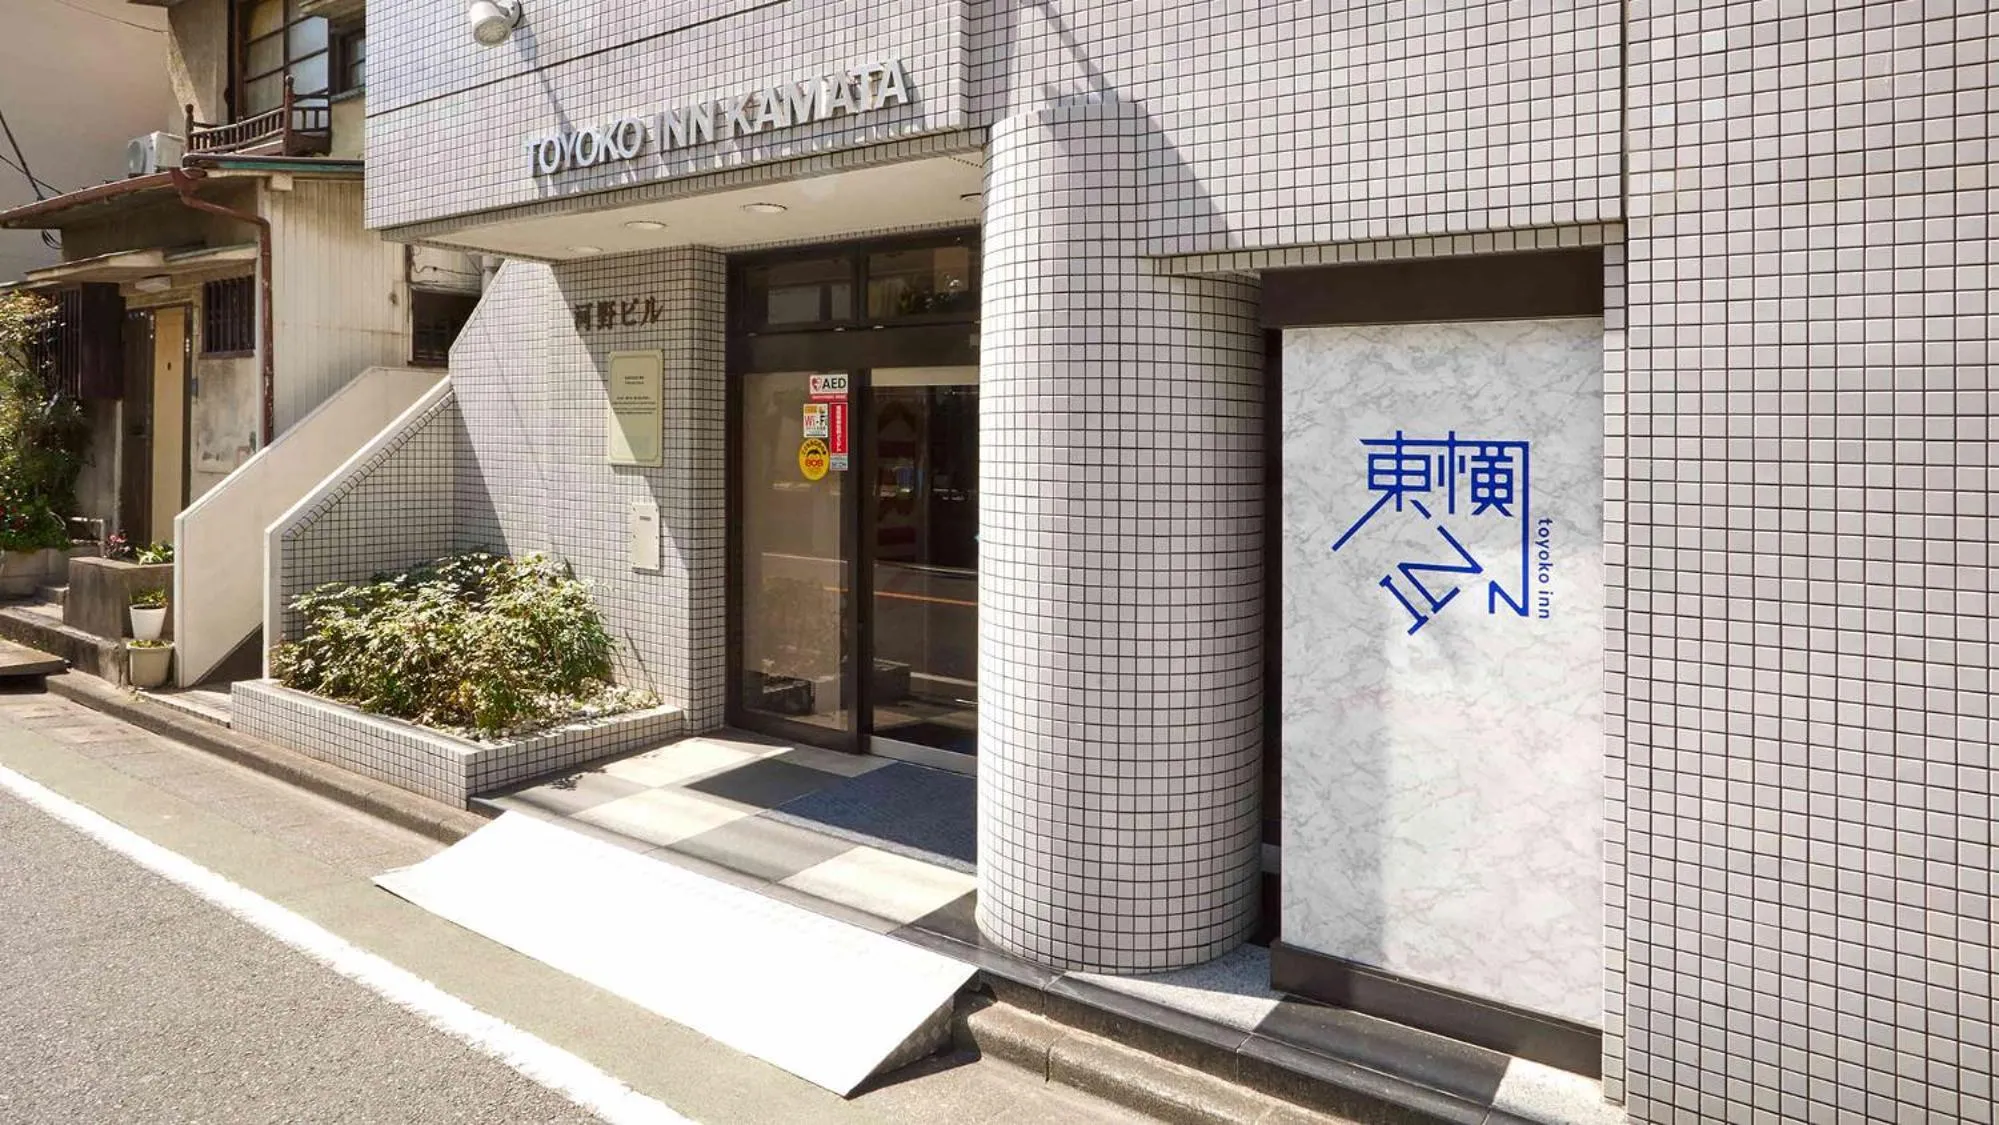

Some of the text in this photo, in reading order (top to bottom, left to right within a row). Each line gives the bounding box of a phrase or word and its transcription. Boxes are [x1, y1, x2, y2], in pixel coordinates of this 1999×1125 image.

[525, 57, 909, 176] TOYOKO INN KAMATA
[822, 377, 847, 389] AED
[1535, 517, 1554, 619] toyoko inn
